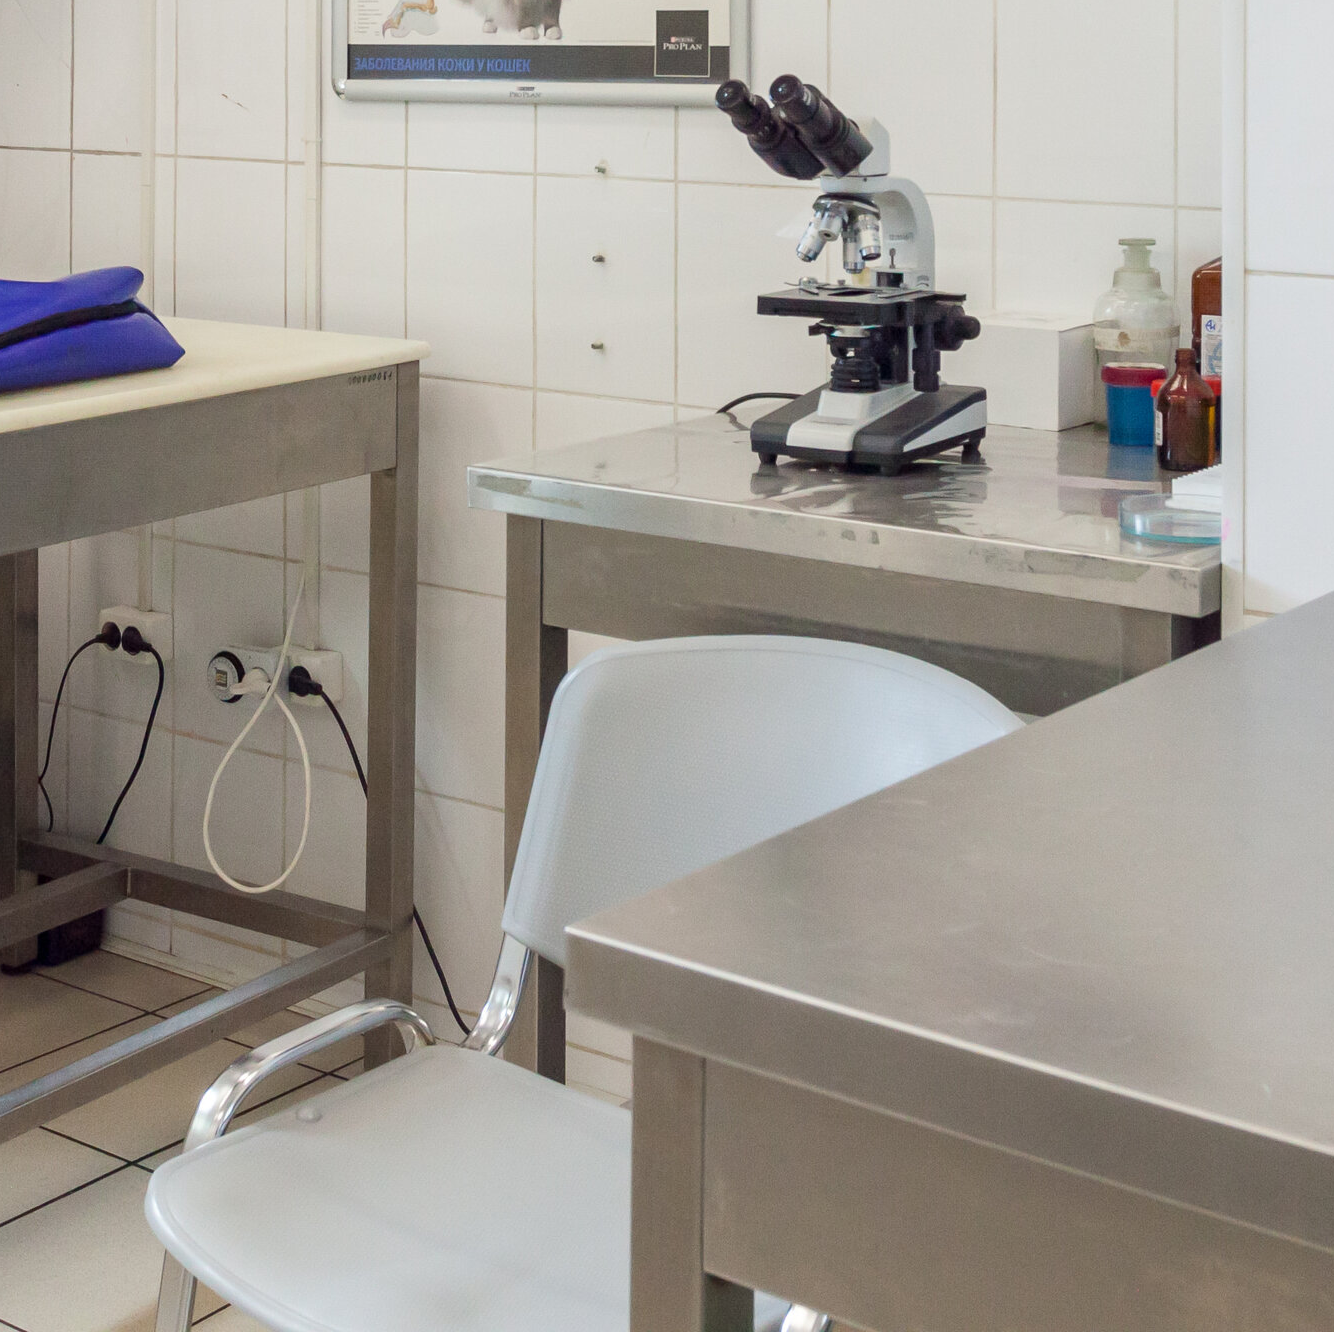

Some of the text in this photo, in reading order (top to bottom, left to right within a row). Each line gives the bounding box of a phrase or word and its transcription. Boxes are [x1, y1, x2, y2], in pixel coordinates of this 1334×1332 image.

[354, 58, 530, 72] ЗАБОЛЕВАНИЯ КОЖИ У КОШЕК
